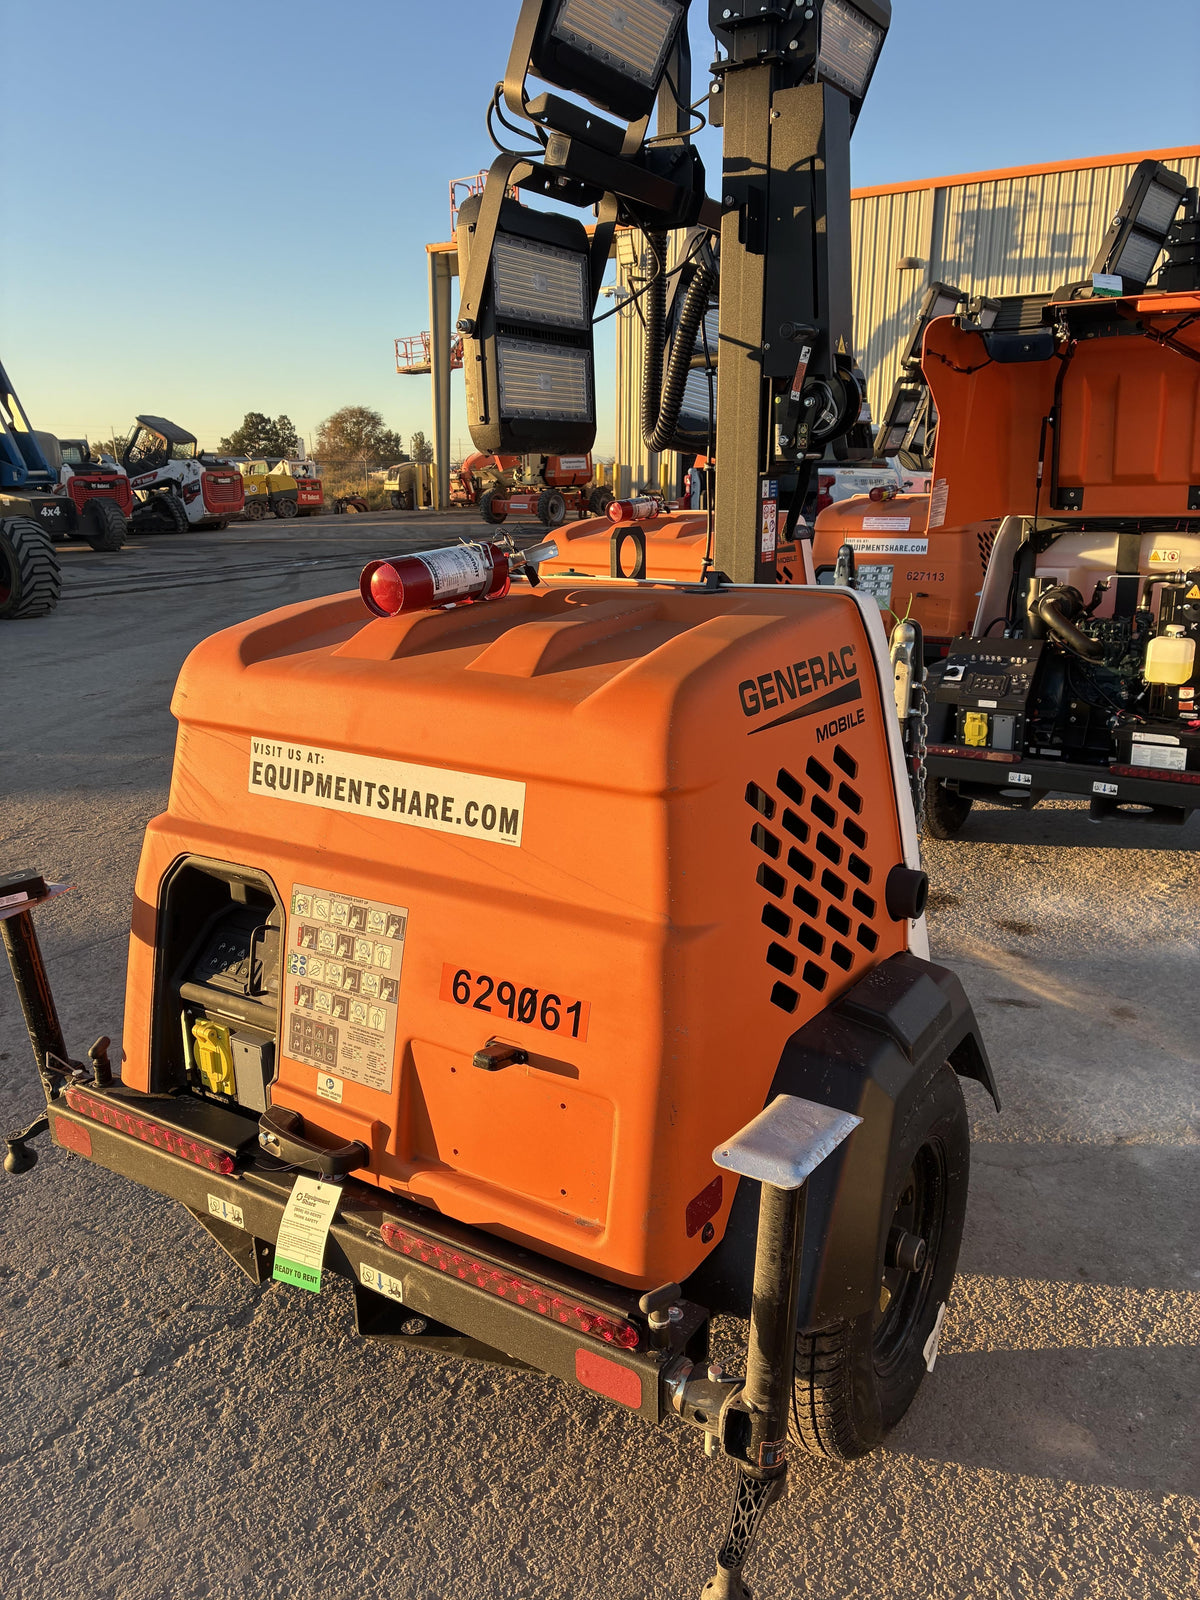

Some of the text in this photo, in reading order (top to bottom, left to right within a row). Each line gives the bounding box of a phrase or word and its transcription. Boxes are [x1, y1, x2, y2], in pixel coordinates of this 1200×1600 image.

[40, 506, 61, 517] 4x4
[853, 544, 927, 553] UIPMENTSHARE.COM
[906, 571, 945, 582] 627113
[738, 645, 858, 718] GENERAC
[816, 707, 865, 743] MOBILE
[252, 742, 325, 765] VISIT US AT:
[251, 761, 520, 836] EQUIPMENTSHARE.COM
[301, 1199, 317, 1208] Share
[303, 1192, 331, 1206] Equipment
[274, 1263, 318, 1285] READY TO RENT
